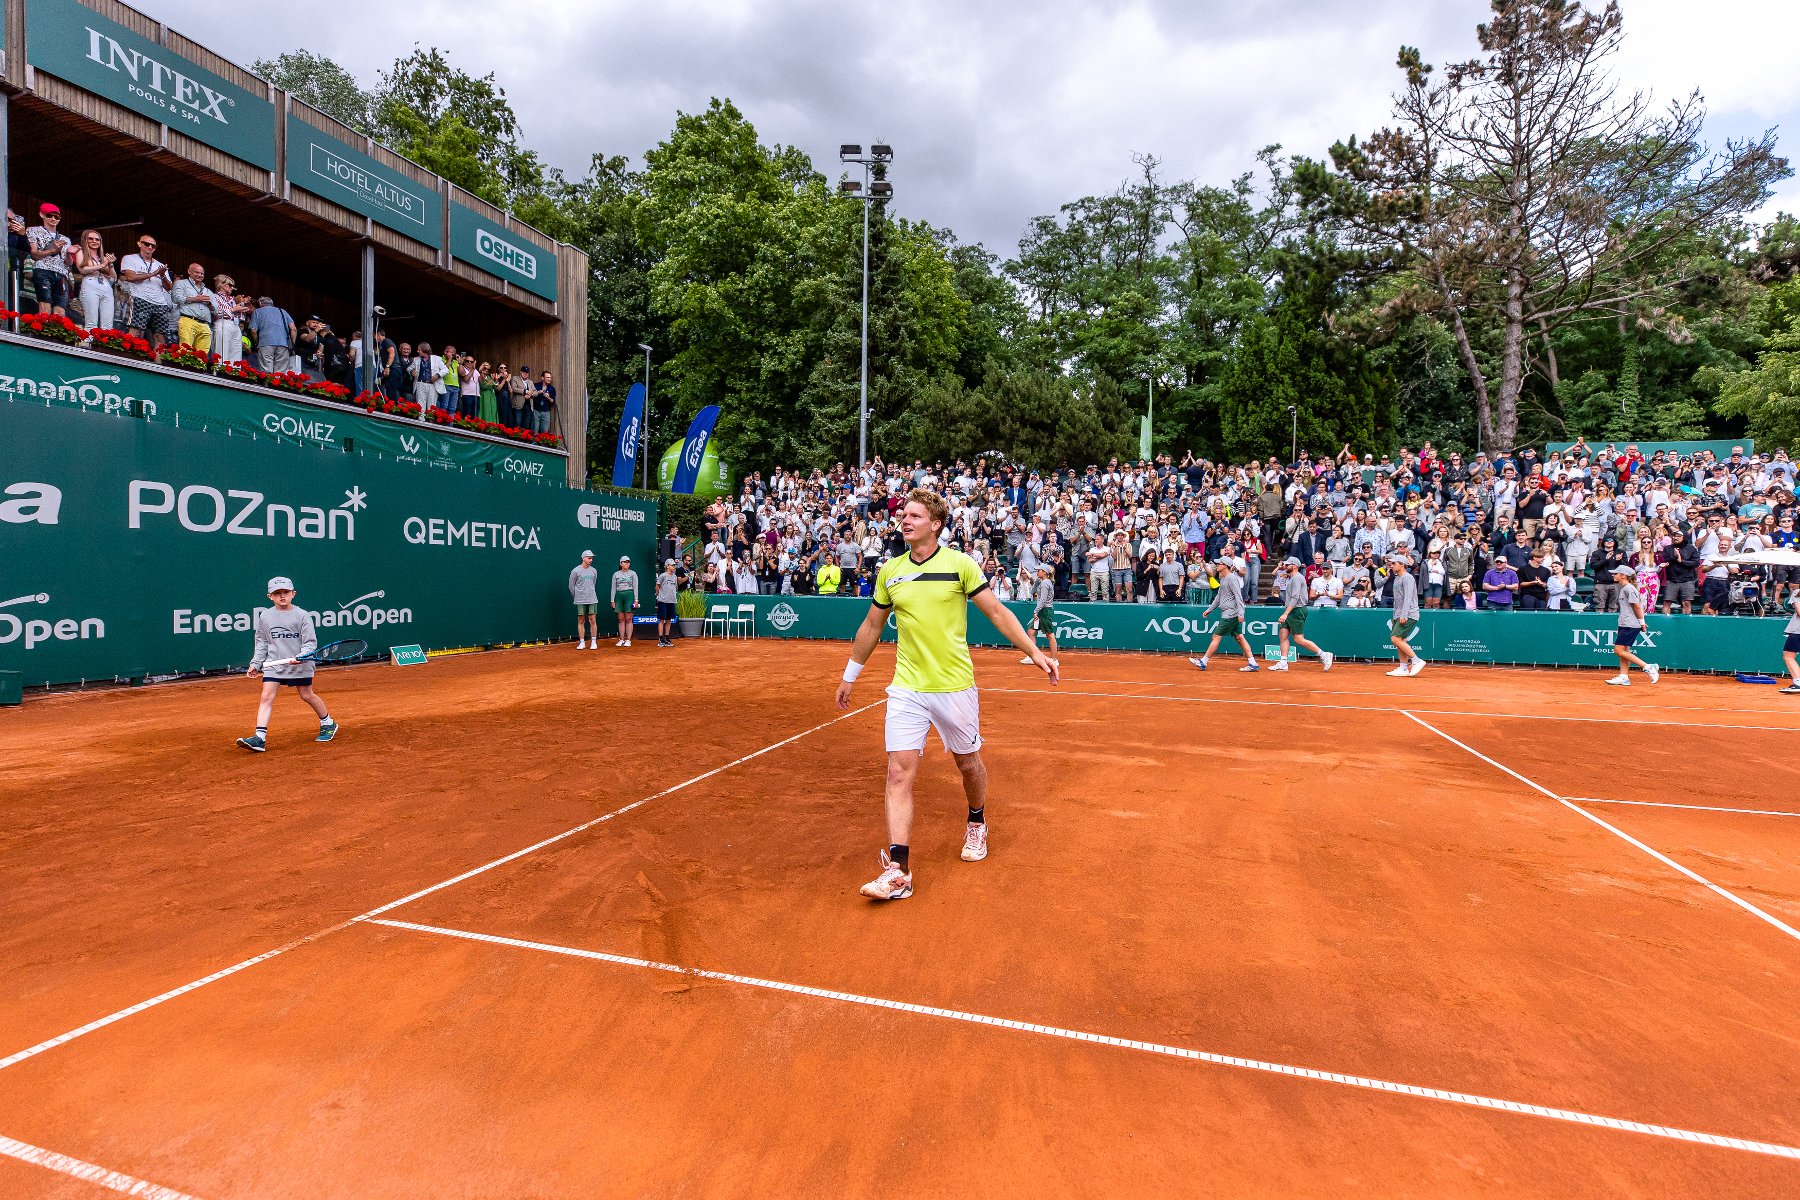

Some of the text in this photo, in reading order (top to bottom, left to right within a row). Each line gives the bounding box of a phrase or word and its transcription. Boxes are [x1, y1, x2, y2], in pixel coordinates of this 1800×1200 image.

[85, 26, 229, 125] INTEX
[128, 83, 201, 124] POOLS & SPA
[327, 157, 372, 192] HOTEL
[374, 183, 412, 211] ALTUS
[480, 235, 534, 276] OSHEE
[262, 413, 336, 443] GOMEZ
[624, 416, 639, 459] Enea
[689, 429, 708, 469] Enea
[503, 457, 544, 477] GOMEZ
[601, 505, 645, 523] CHALLENGER
[602, 518, 621, 532] TOUR
[403, 516, 542, 551] QEMETICA
[271, 631, 300, 639] Enea
[1571, 629, 1657, 648] INTX
